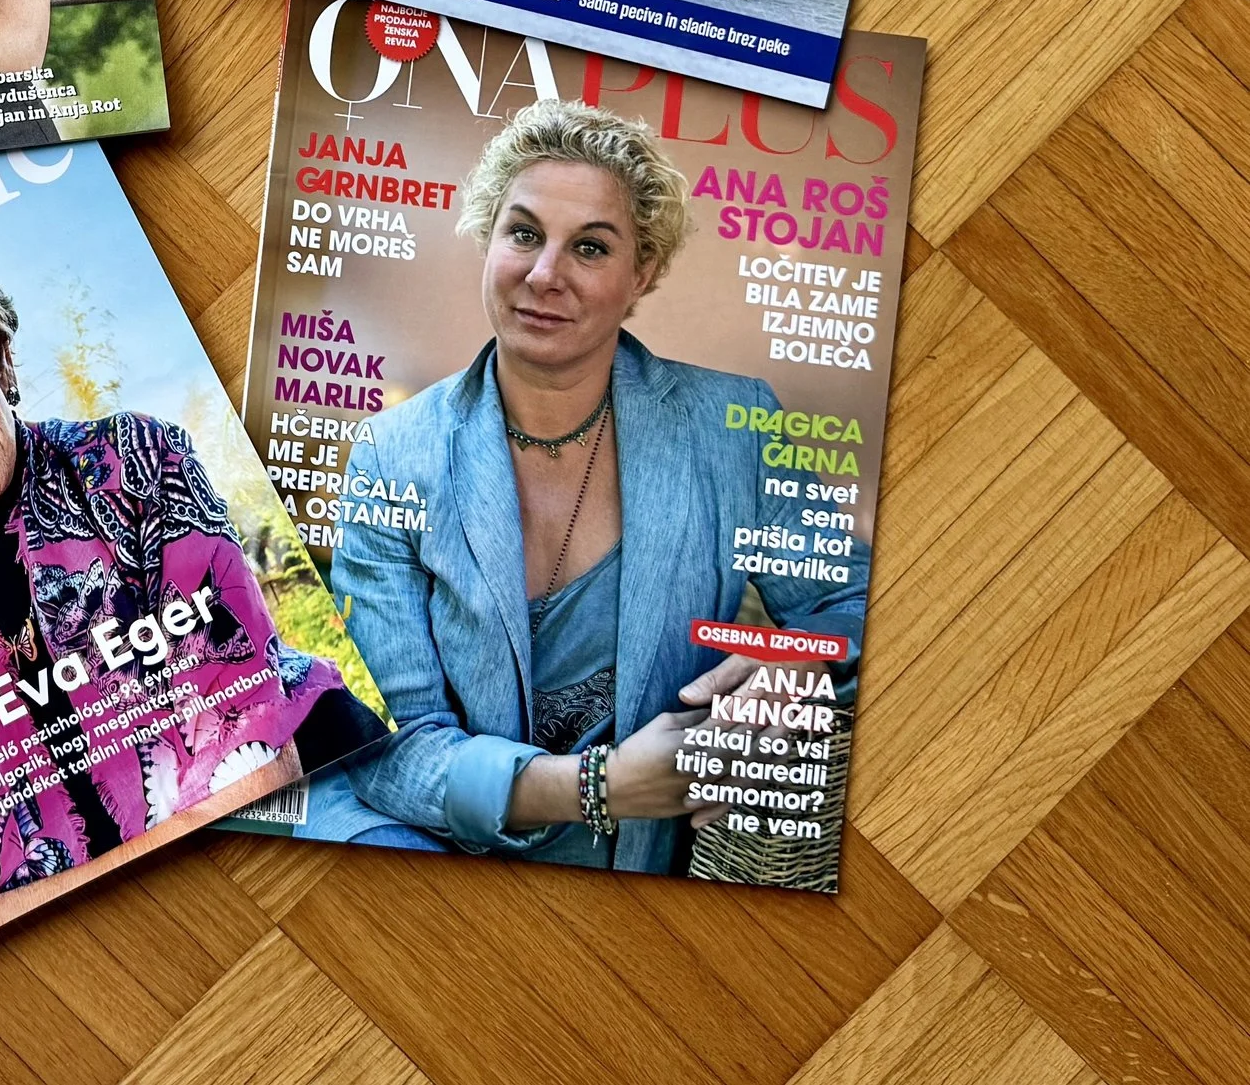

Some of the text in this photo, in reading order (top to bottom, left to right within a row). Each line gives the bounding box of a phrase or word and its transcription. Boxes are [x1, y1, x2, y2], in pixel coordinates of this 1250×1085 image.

[374, 15, 432, 29] PRODAJANA
[384, 25, 419, 38] ŽENSKA
[385, 37, 417, 48] REVIJA
[620, 0, 662, 26] peciva
[665, 13, 677, 27] in
[679, 17, 725, 41] sladice
[728, 28, 755, 47] brez
[757, 37, 790, 56] peke
[28, 106, 47, 121] in
[50, 104, 89, 120] Anja
[92, 98, 121, 113] Rot
[299, 132, 407, 170] JANJA
[295, 166, 457, 210] GARNBRET
[692, 166, 889, 219] ANA ROŠ
[718, 206, 884, 256] STOJAN
[725, 404, 864, 444] DRAGICA
[762, 436, 860, 477] ČARNA
[90, 585, 219, 668] Eger
[698, 626, 840, 655] OSEBNA IZPOVED
[20, 693, 120, 754] pszichológus
[121, 681, 142, 700] 93
[144, 654, 199, 688] évesen
[750, 666, 836, 701] ANJA
[51, 734, 91, 760] hogy
[95, 680, 198, 736] megmutassa,
[69, 739, 120, 776] találni
[122, 713, 180, 748] minden
[182, 667, 277, 722] pillanatban.
